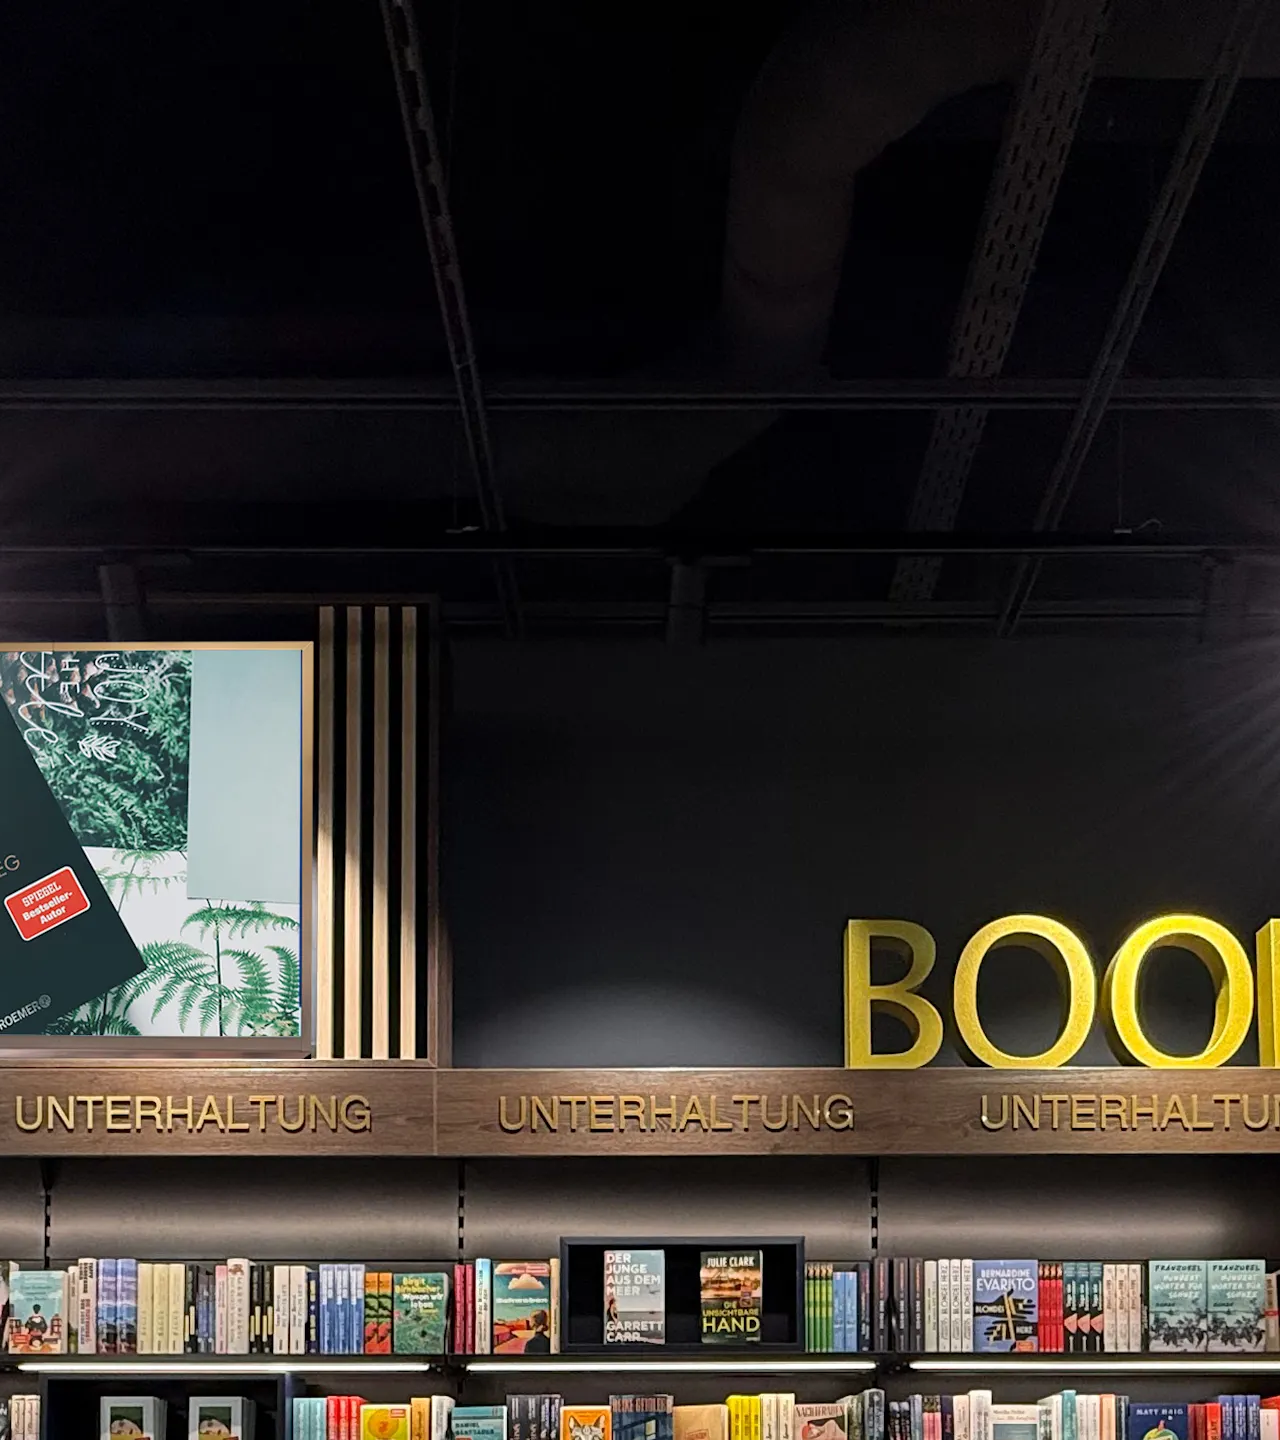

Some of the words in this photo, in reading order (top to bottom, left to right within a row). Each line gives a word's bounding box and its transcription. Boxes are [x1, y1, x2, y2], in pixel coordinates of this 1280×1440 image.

[22, 882, 62, 907] SPIEGEL
[23, 891, 73, 921] Bestseller-
[40, 905, 66, 925] Autor
[16, 1095, 373, 1133] UNTERHALTUNG
[498, 1095, 854, 1133] UNTERHALTUNG
[607, 1253, 631, 1264] DER
[707, 1256, 729, 1267] JULIE
[731, 1256, 754, 1268] CLARK
[607, 1263, 647, 1275] JUNGE
[981, 1268, 1030, 1279] BERNARDINE
[607, 1274, 631, 1285] AUS
[634, 1274, 661, 1285] DEM
[976, 1277, 1035, 1293] EVARISTO
[607, 1285, 640, 1297] MEER
[702, 1308, 760, 1318] UNSICHTBARE
[607, 1320, 663, 1331] GARRETT
[702, 1316, 760, 1333] HAND
[607, 1332, 640, 1343] CARR
